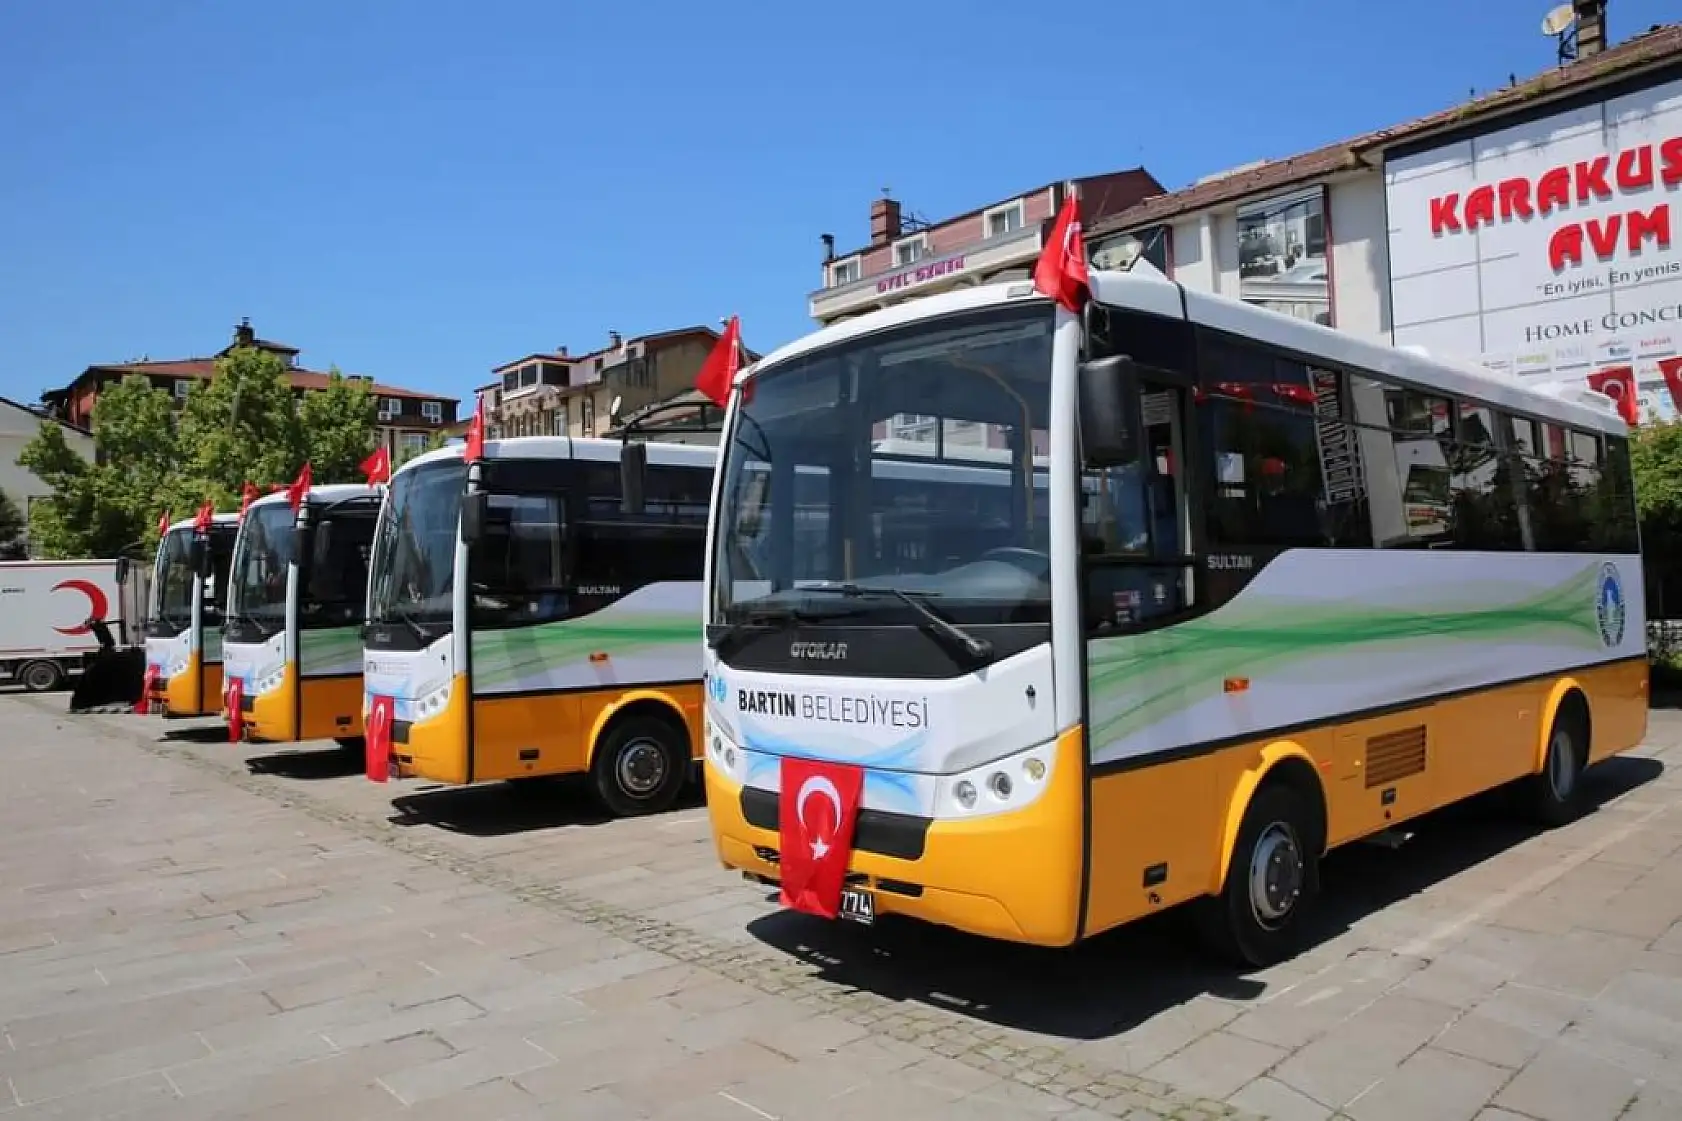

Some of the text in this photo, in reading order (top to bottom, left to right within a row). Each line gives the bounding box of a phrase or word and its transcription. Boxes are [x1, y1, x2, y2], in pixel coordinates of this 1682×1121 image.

[1548, 203, 1670, 270] AVM
[1609, 269, 1631, 285] En
[1525, 303, 1682, 342] HOME CONC
[1207, 554, 1253, 570] SULTAN
[577, 584, 621, 594] SULTAN
[790, 641, 848, 660] OTOKAR
[738, 688, 796, 717] BARTIN
[801, 692, 928, 729] BELEDİYESİ
